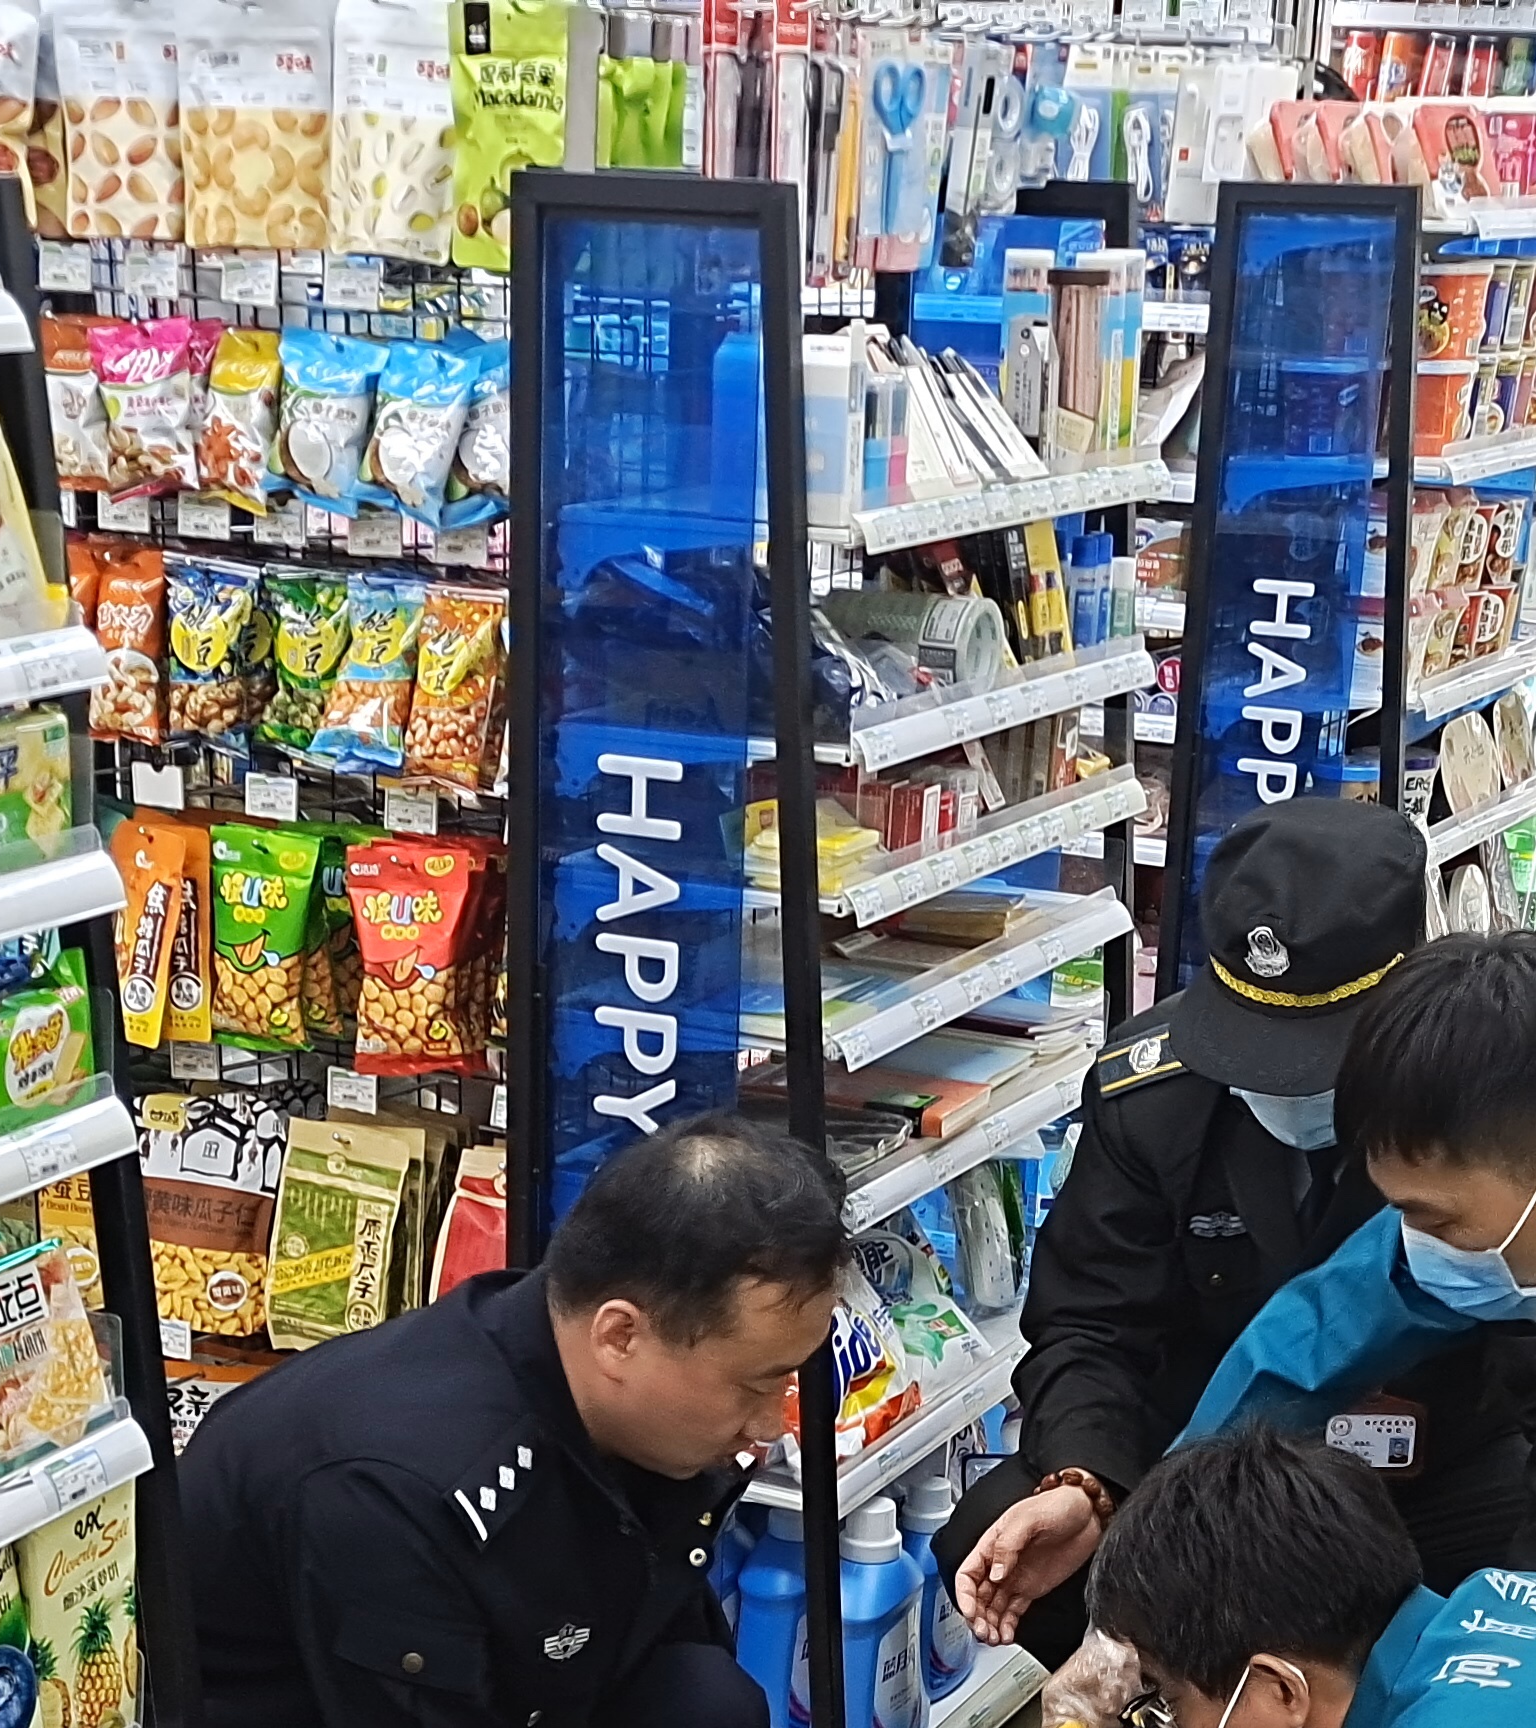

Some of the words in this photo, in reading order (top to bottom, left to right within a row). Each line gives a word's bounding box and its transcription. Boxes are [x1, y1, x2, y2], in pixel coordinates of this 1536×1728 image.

[1236, 577, 1316, 806] HAPP
[362, 891, 444, 927] 怪U味
[831, 1309, 890, 1400] ide
